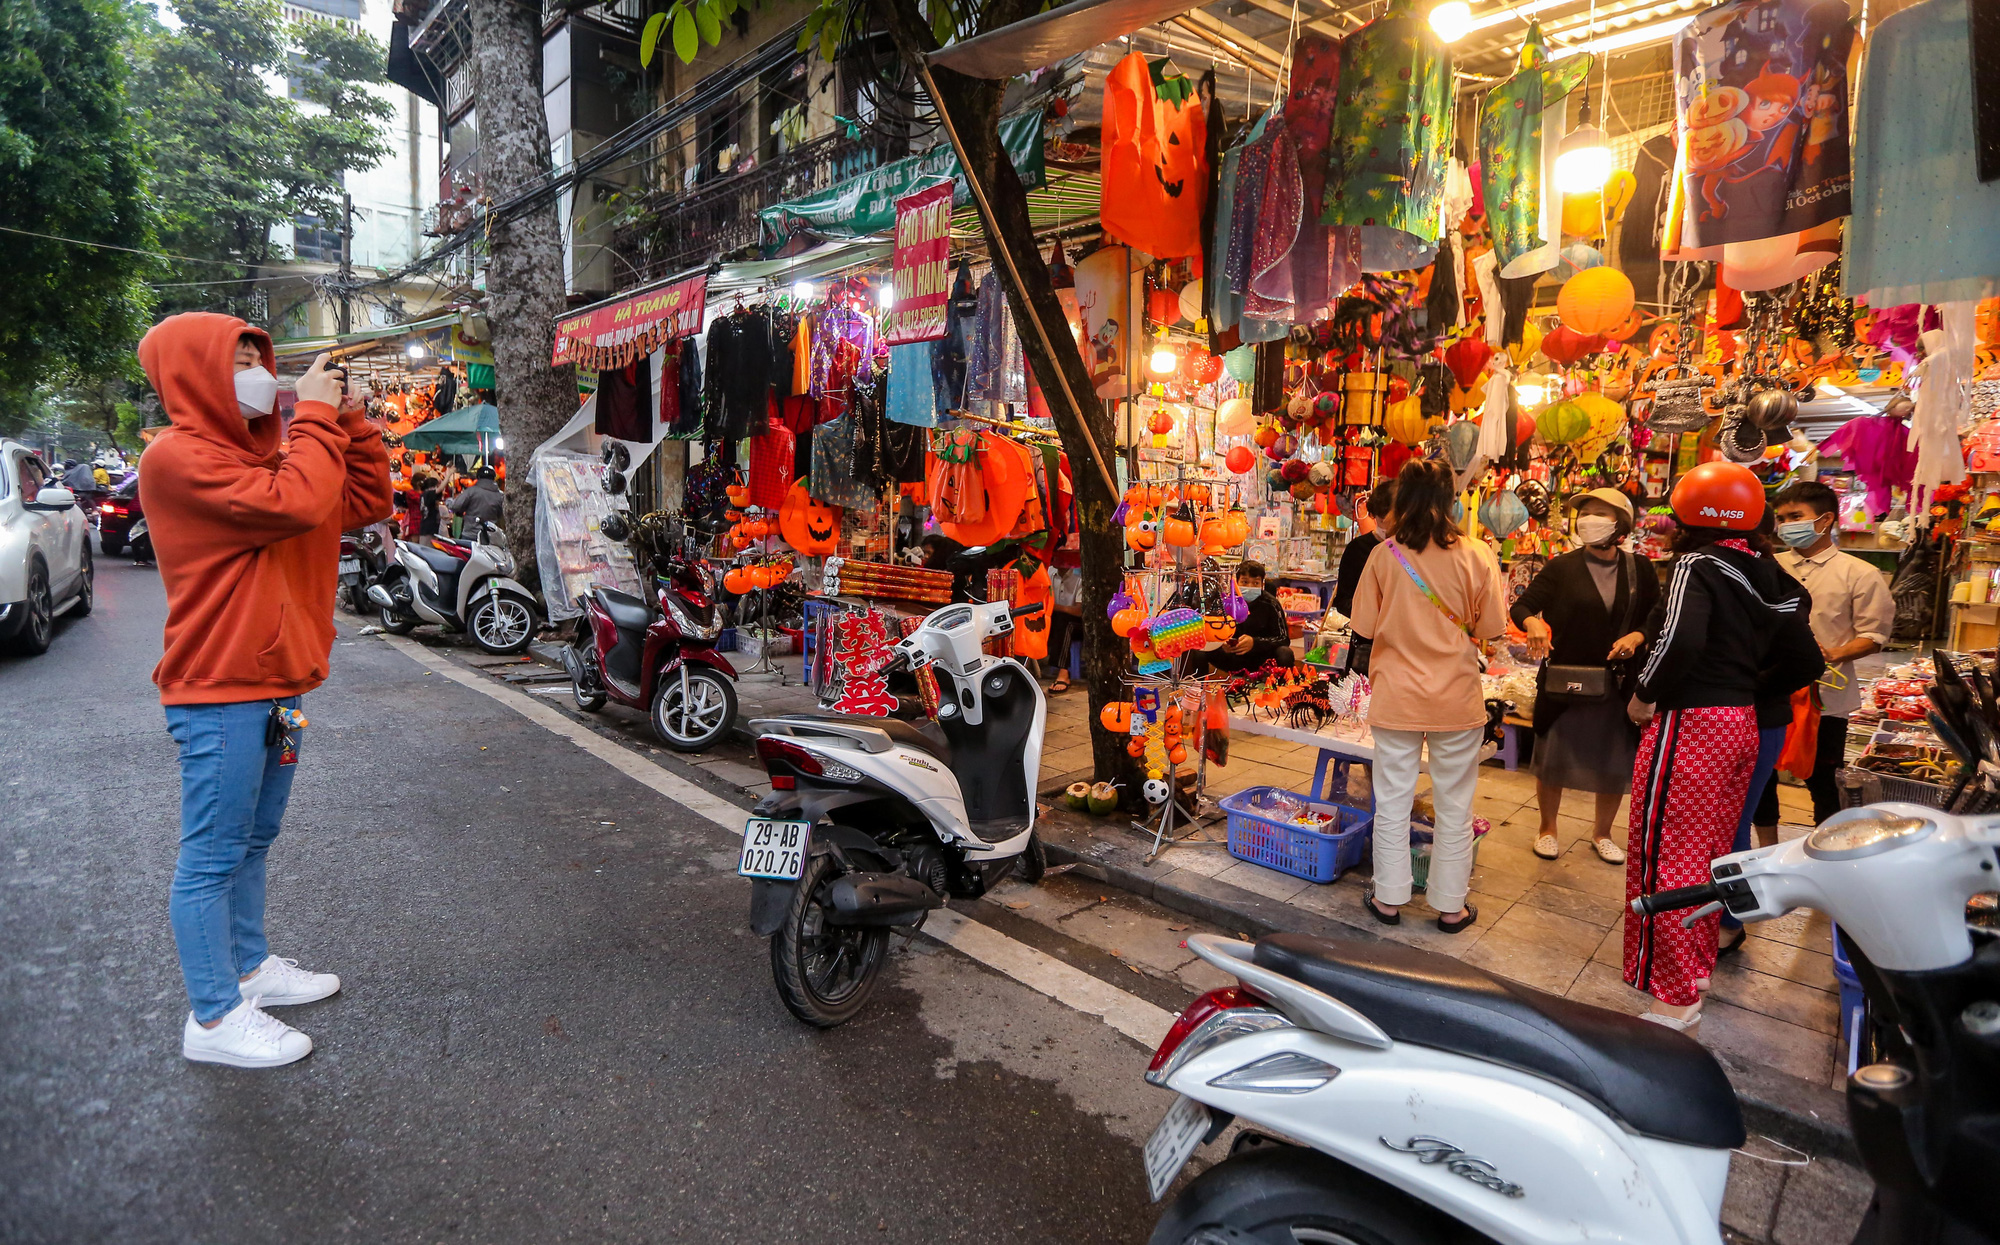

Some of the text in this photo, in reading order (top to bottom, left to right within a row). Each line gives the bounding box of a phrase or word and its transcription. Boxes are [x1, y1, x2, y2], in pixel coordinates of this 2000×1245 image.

[1796, 182, 1850, 207] Octobe
[1805, 185, 1820, 194] or
[898, 209, 918, 250] CHO
[922, 196, 950, 243] THUÊ
[893, 254, 948, 301] CỬA HÀNG
[614, 291, 681, 323] HÀ TRANG
[1720, 509, 1744, 519] MSB
[753, 822, 800, 848] 29-AB
[744, 848, 800, 875] 020.76
